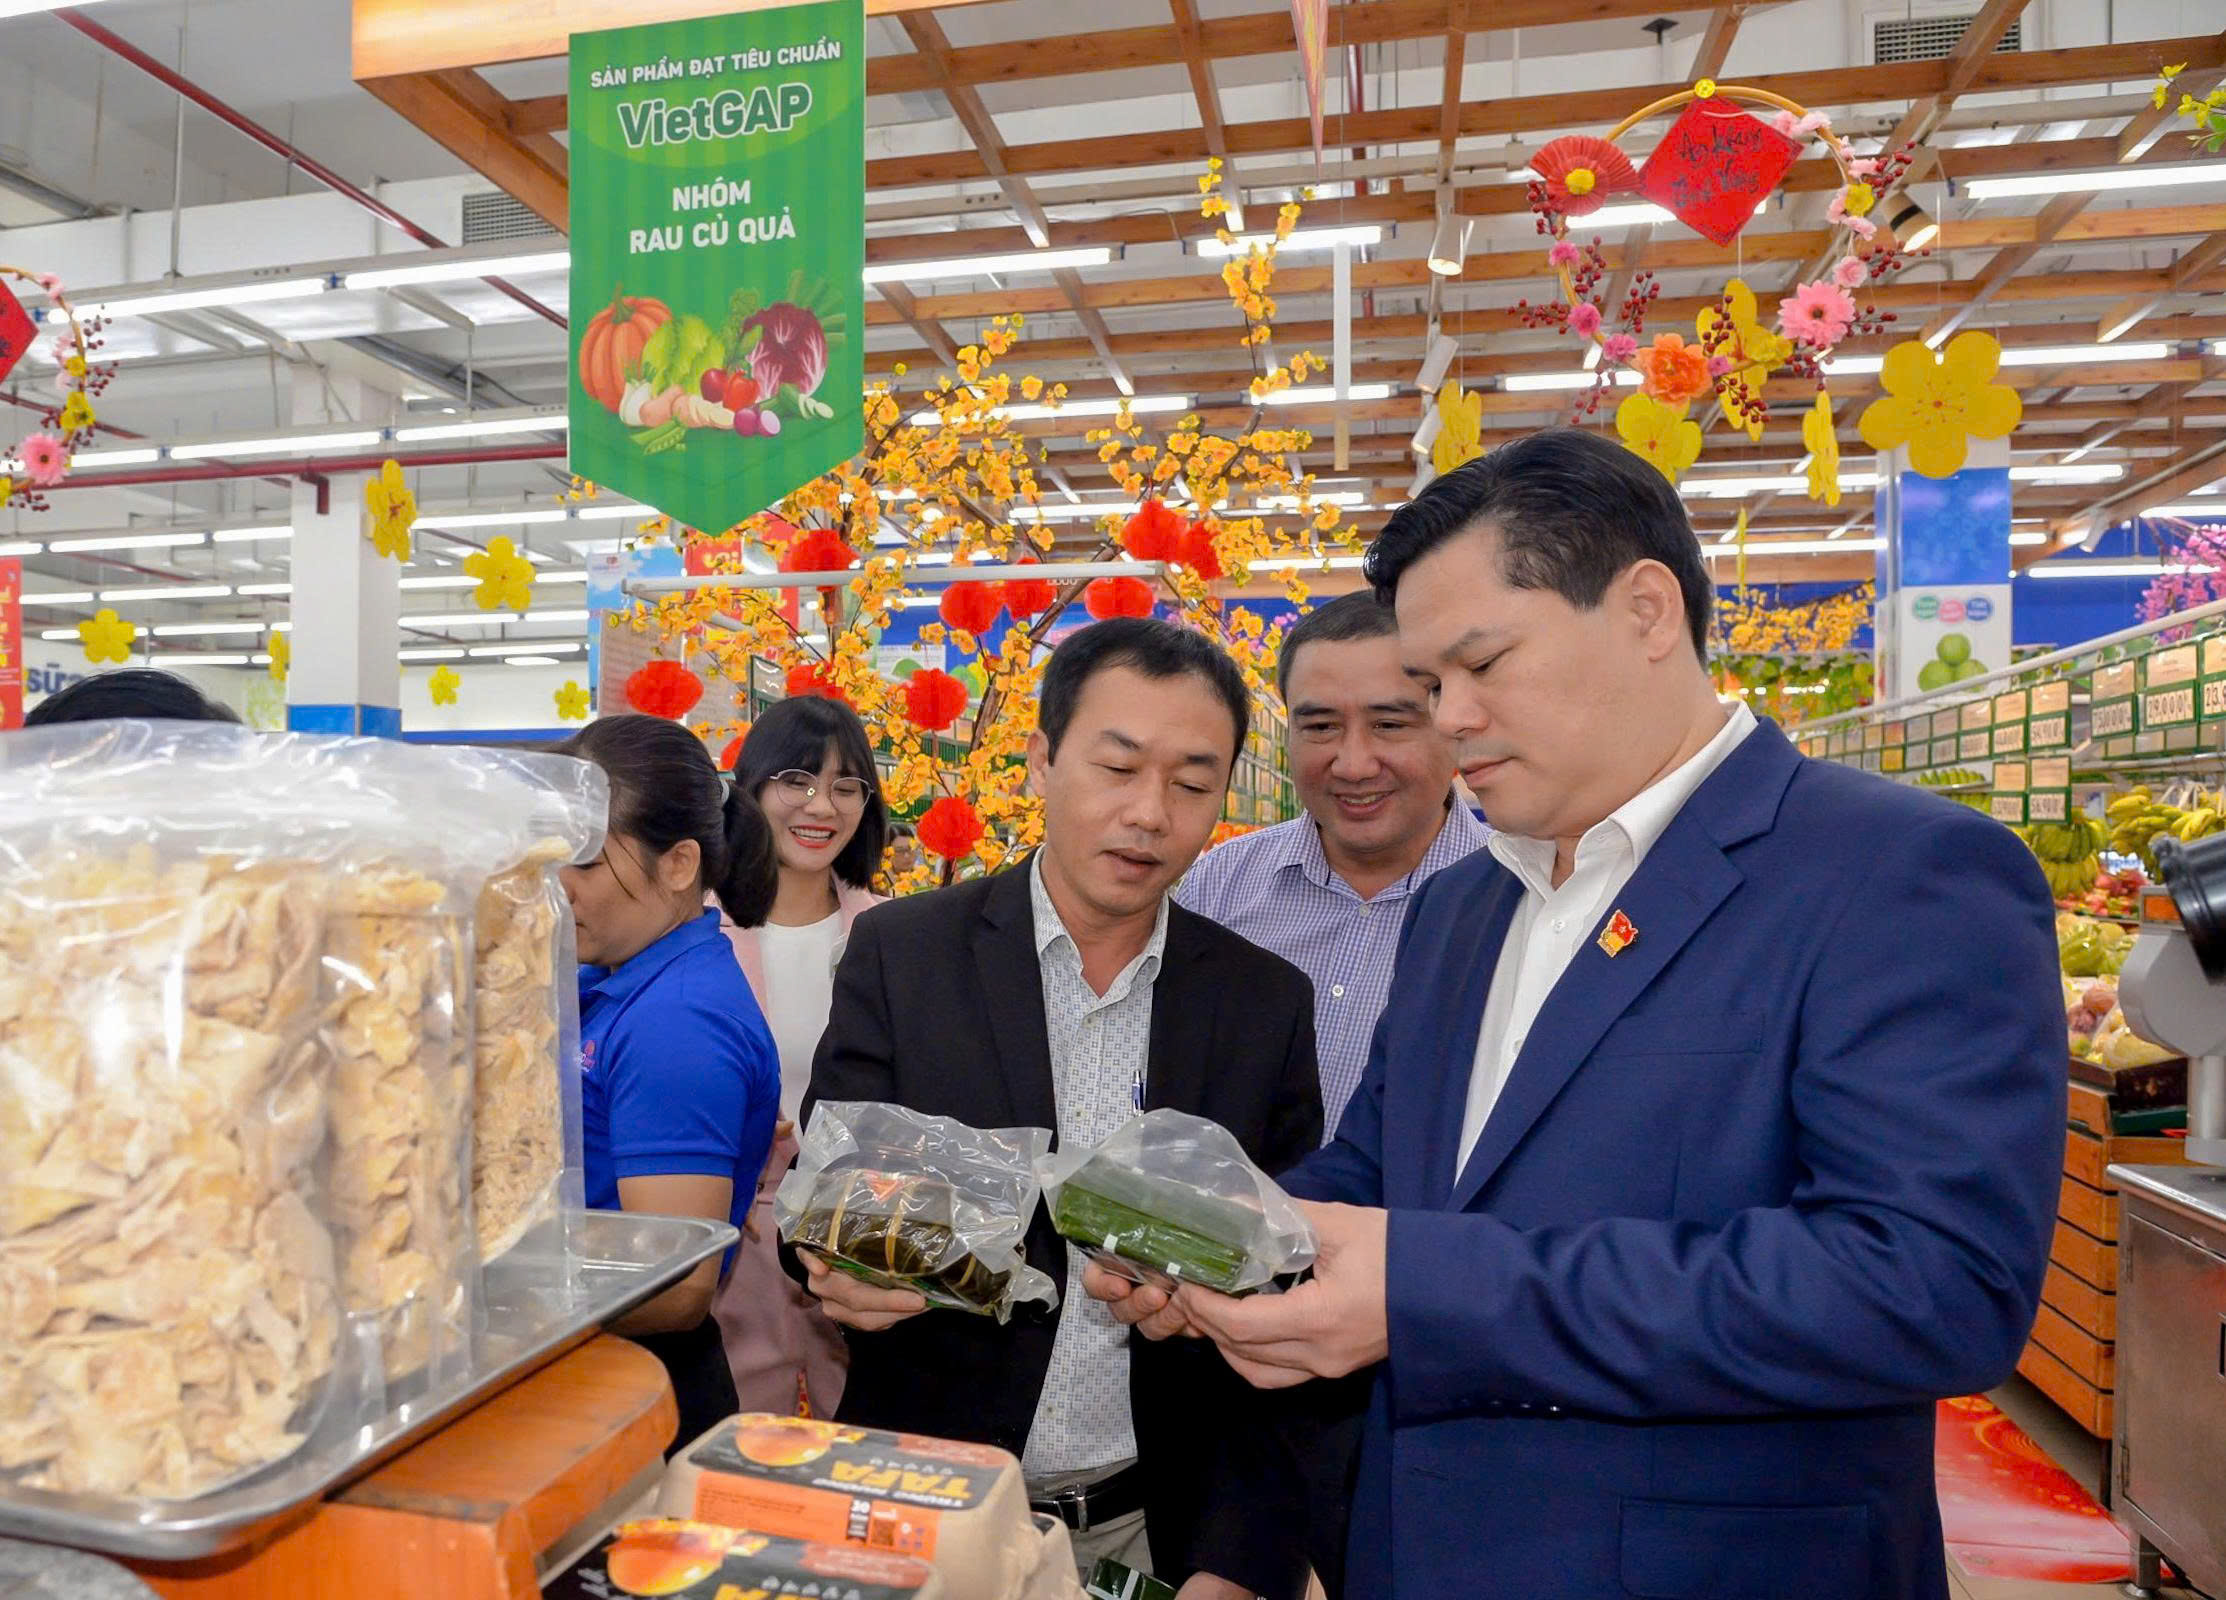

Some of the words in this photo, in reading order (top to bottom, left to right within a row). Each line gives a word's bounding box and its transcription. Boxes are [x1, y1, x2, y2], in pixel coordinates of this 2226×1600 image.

[591, 65, 627, 88] SẢN
[632, 56, 684, 83] PHẨM
[689, 56, 726, 79] ĐẠT
[731, 48, 771, 71] TIÊU
[777, 36, 841, 65] CHUẨN
[617, 82, 813, 148] VietGAP
[673, 176, 751, 212] NHÓM
[630, 225, 684, 255] RAU
[692, 212, 729, 247] CỦ
[738, 206, 796, 245] QUẢ
[831, 1460, 973, 1499] TAFA
